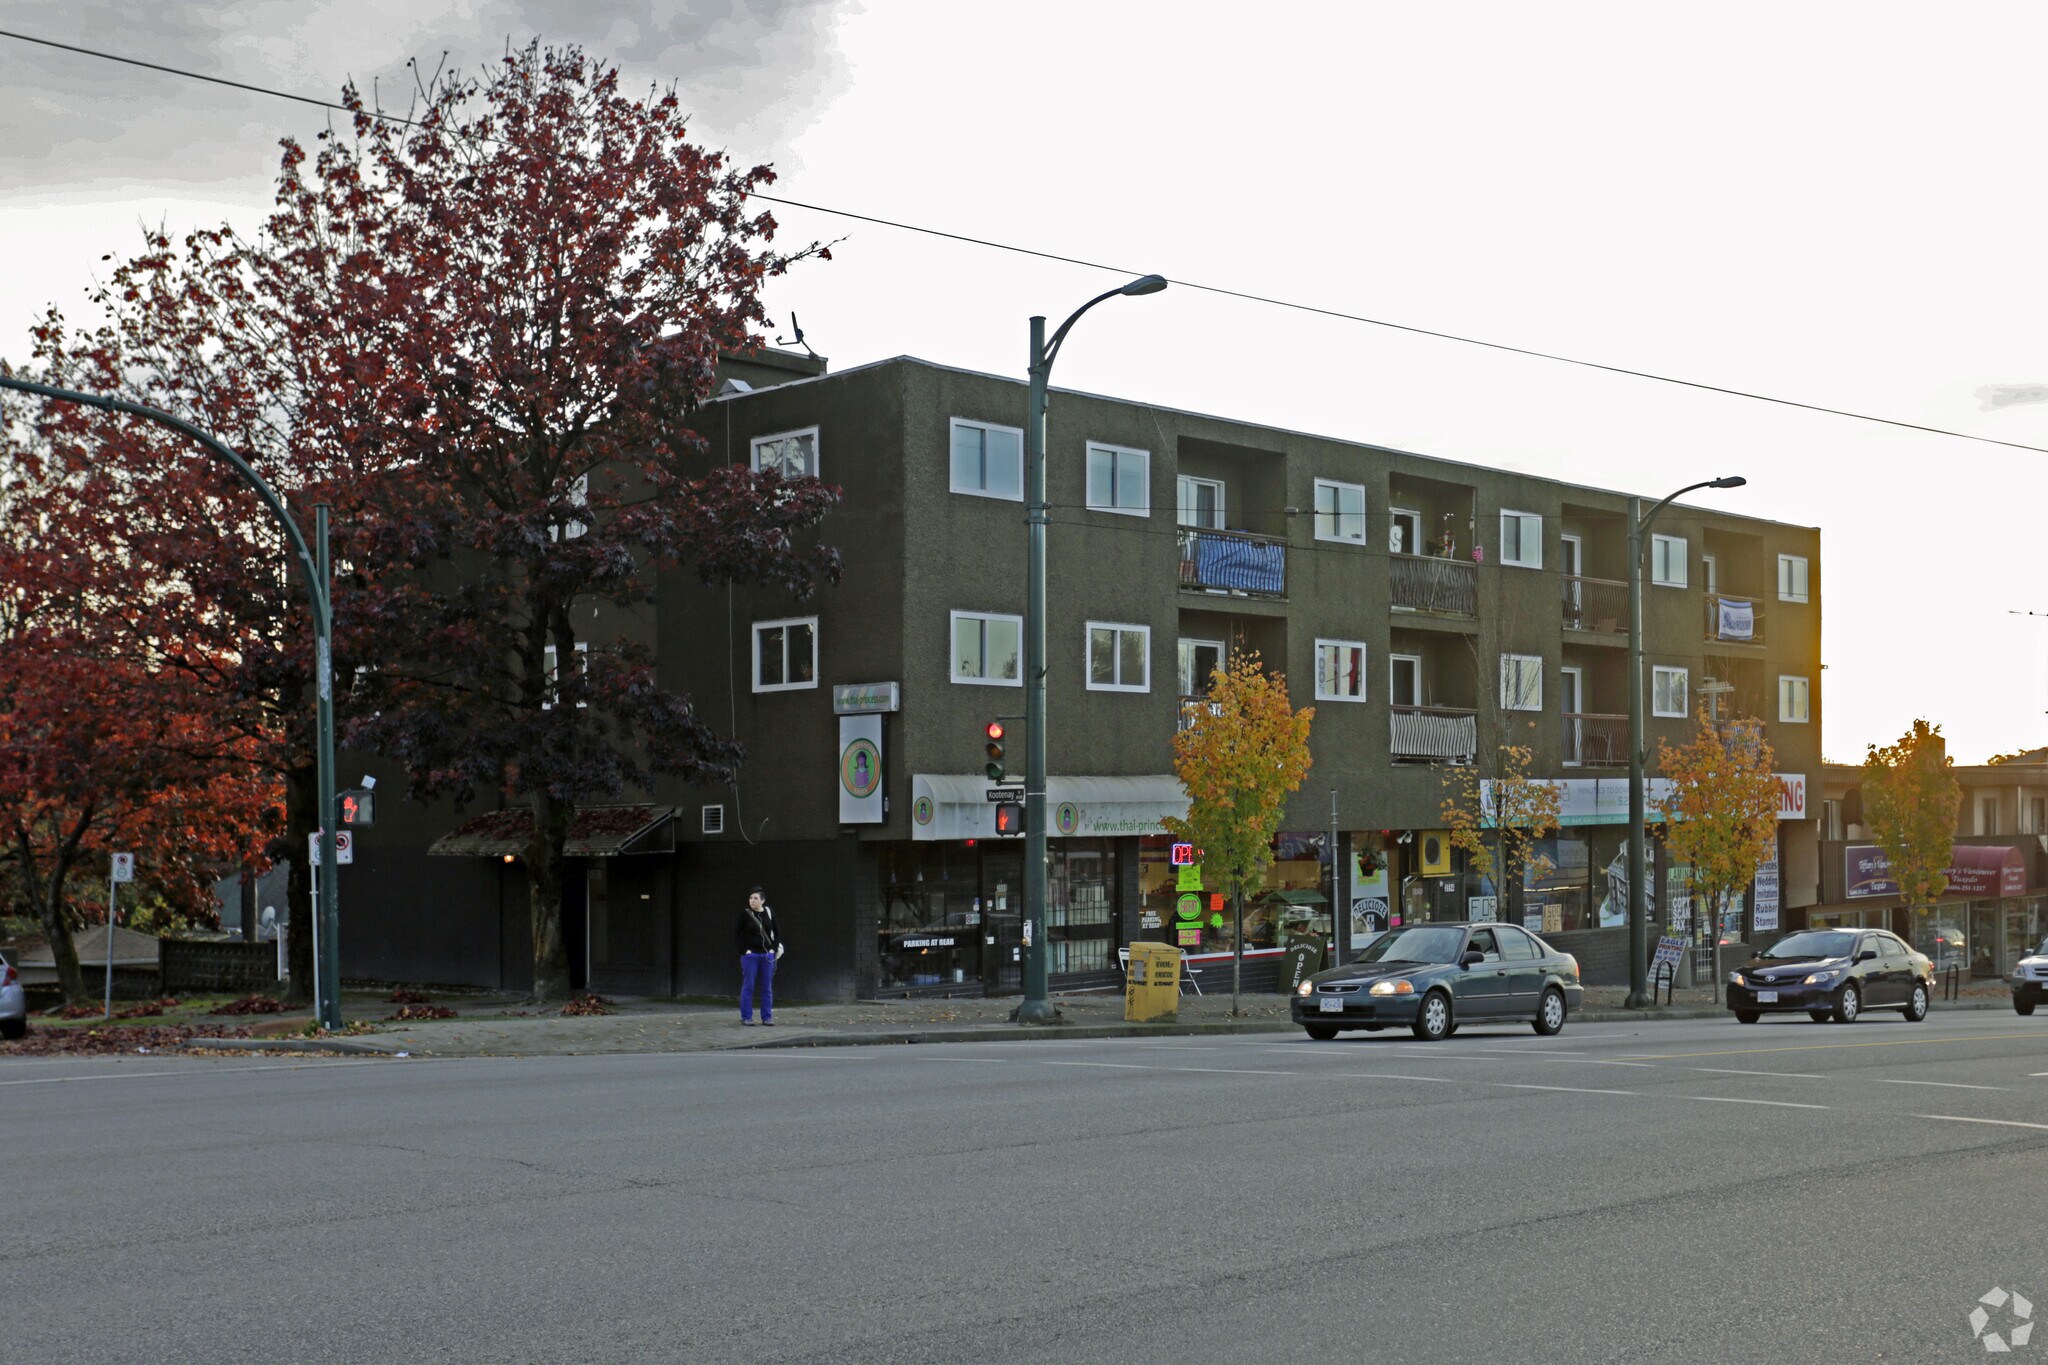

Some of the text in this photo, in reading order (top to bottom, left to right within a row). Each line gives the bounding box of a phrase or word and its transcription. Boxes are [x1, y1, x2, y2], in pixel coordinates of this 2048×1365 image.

[988, 791, 1015, 800] Kootenay
[1093, 819, 1167, 834] www.thai-prince
[1173, 845, 1204, 864] OPE
[1962, 867, 1997, 876] Vancouver
[1756, 875, 1777, 887] Wedding
[1951, 875, 1978, 884] Tuxedo
[1756, 888, 1777, 899] Invitations
[1471, 898, 1497, 916] FOR
[1673, 896, 1691, 909] COPY
[1353, 899, 1388, 918] DELICIOZE
[1673, 908, 1691, 919] SCAN
[1755, 904, 1777, 914] Rubber
[1673, 919, 1686, 931] FAX
[1755, 917, 1777, 927] Stamps
[903, 939, 930, 948] PARKING
[939, 938, 954, 946] REAR
[1660, 937, 1685, 946] EAGLE
[1290, 943, 1318, 954] DELICIOZE
[1659, 943, 1684, 952] PRINTING
[1292, 953, 1305, 988] OPEN
